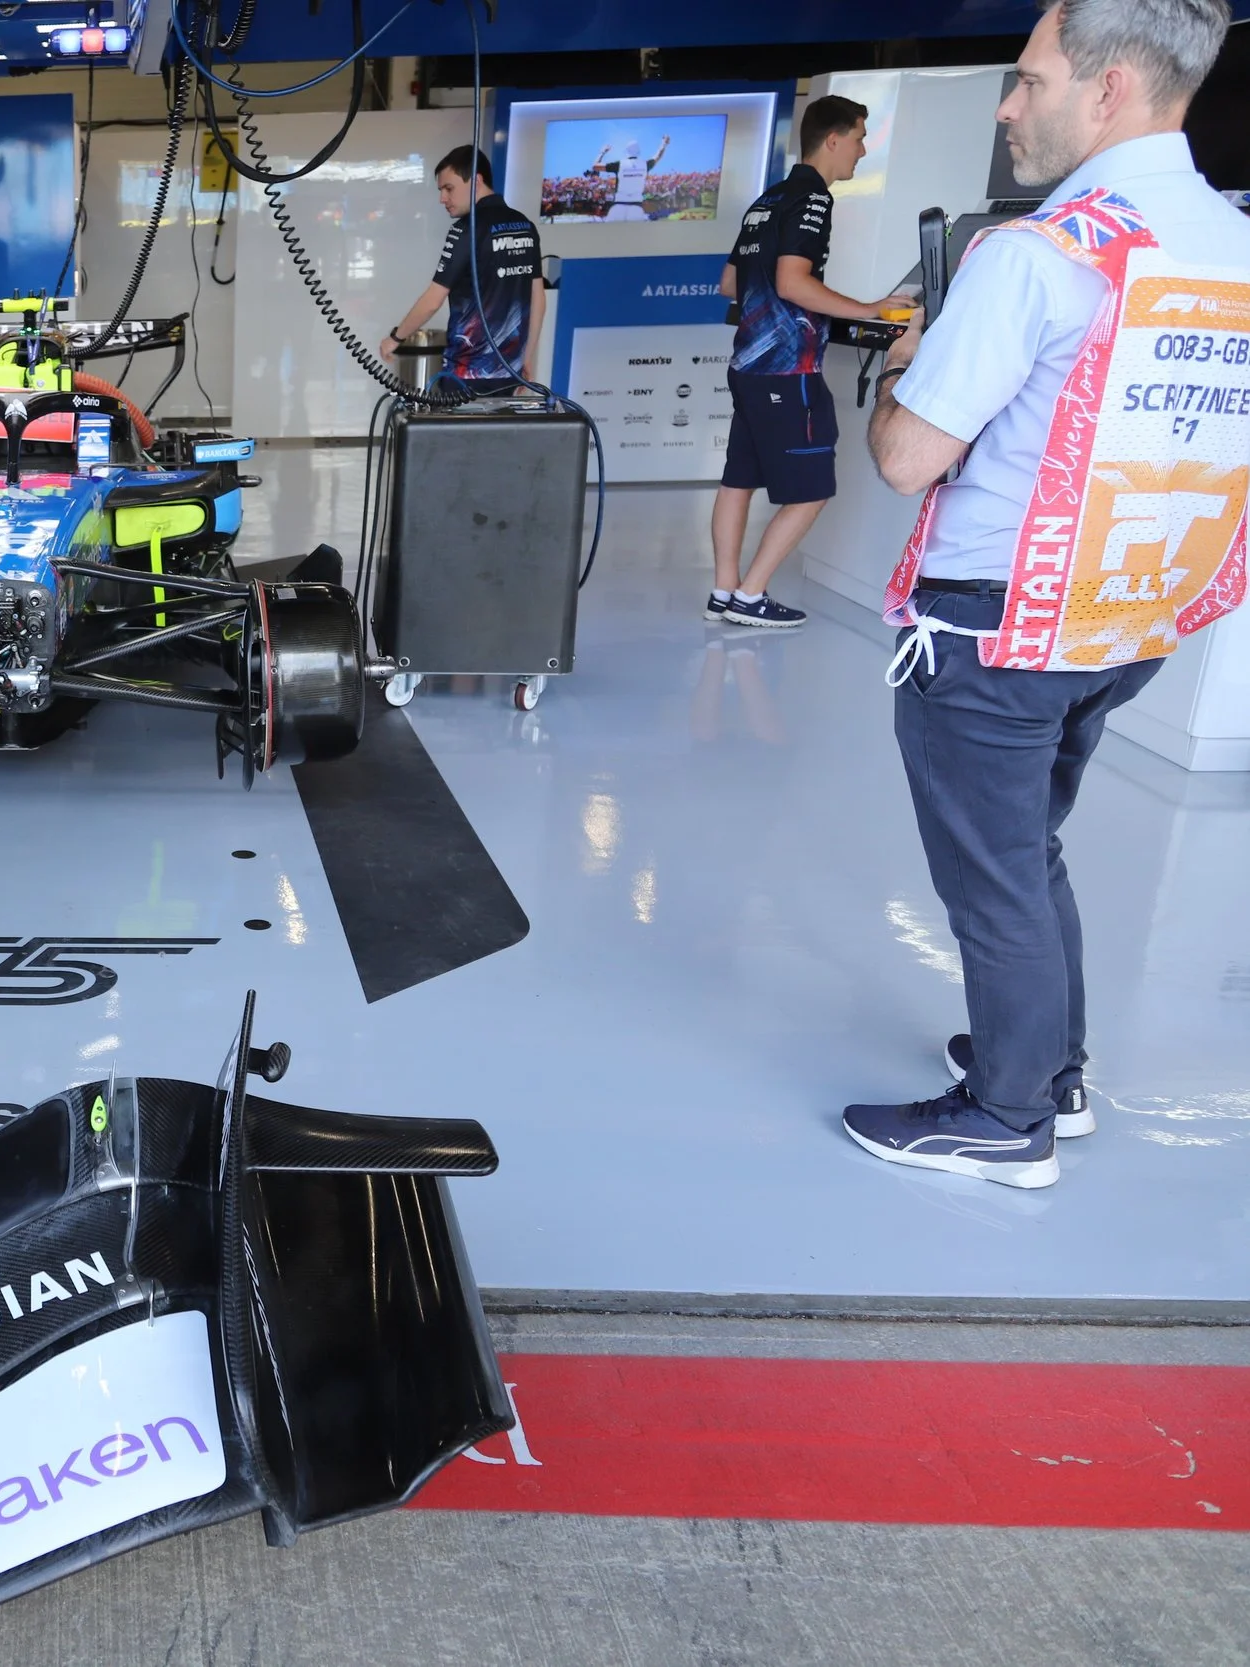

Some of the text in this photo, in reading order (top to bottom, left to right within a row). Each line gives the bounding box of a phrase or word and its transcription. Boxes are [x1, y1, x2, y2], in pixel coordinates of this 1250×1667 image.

[1154, 334, 1250, 366] 0083-GB
[629, 356, 672, 366] KOMATSU
[634, 388, 654, 396] BNY
[82, 397, 100, 407] airia
[204, 448, 240, 458] BARCLAYS
